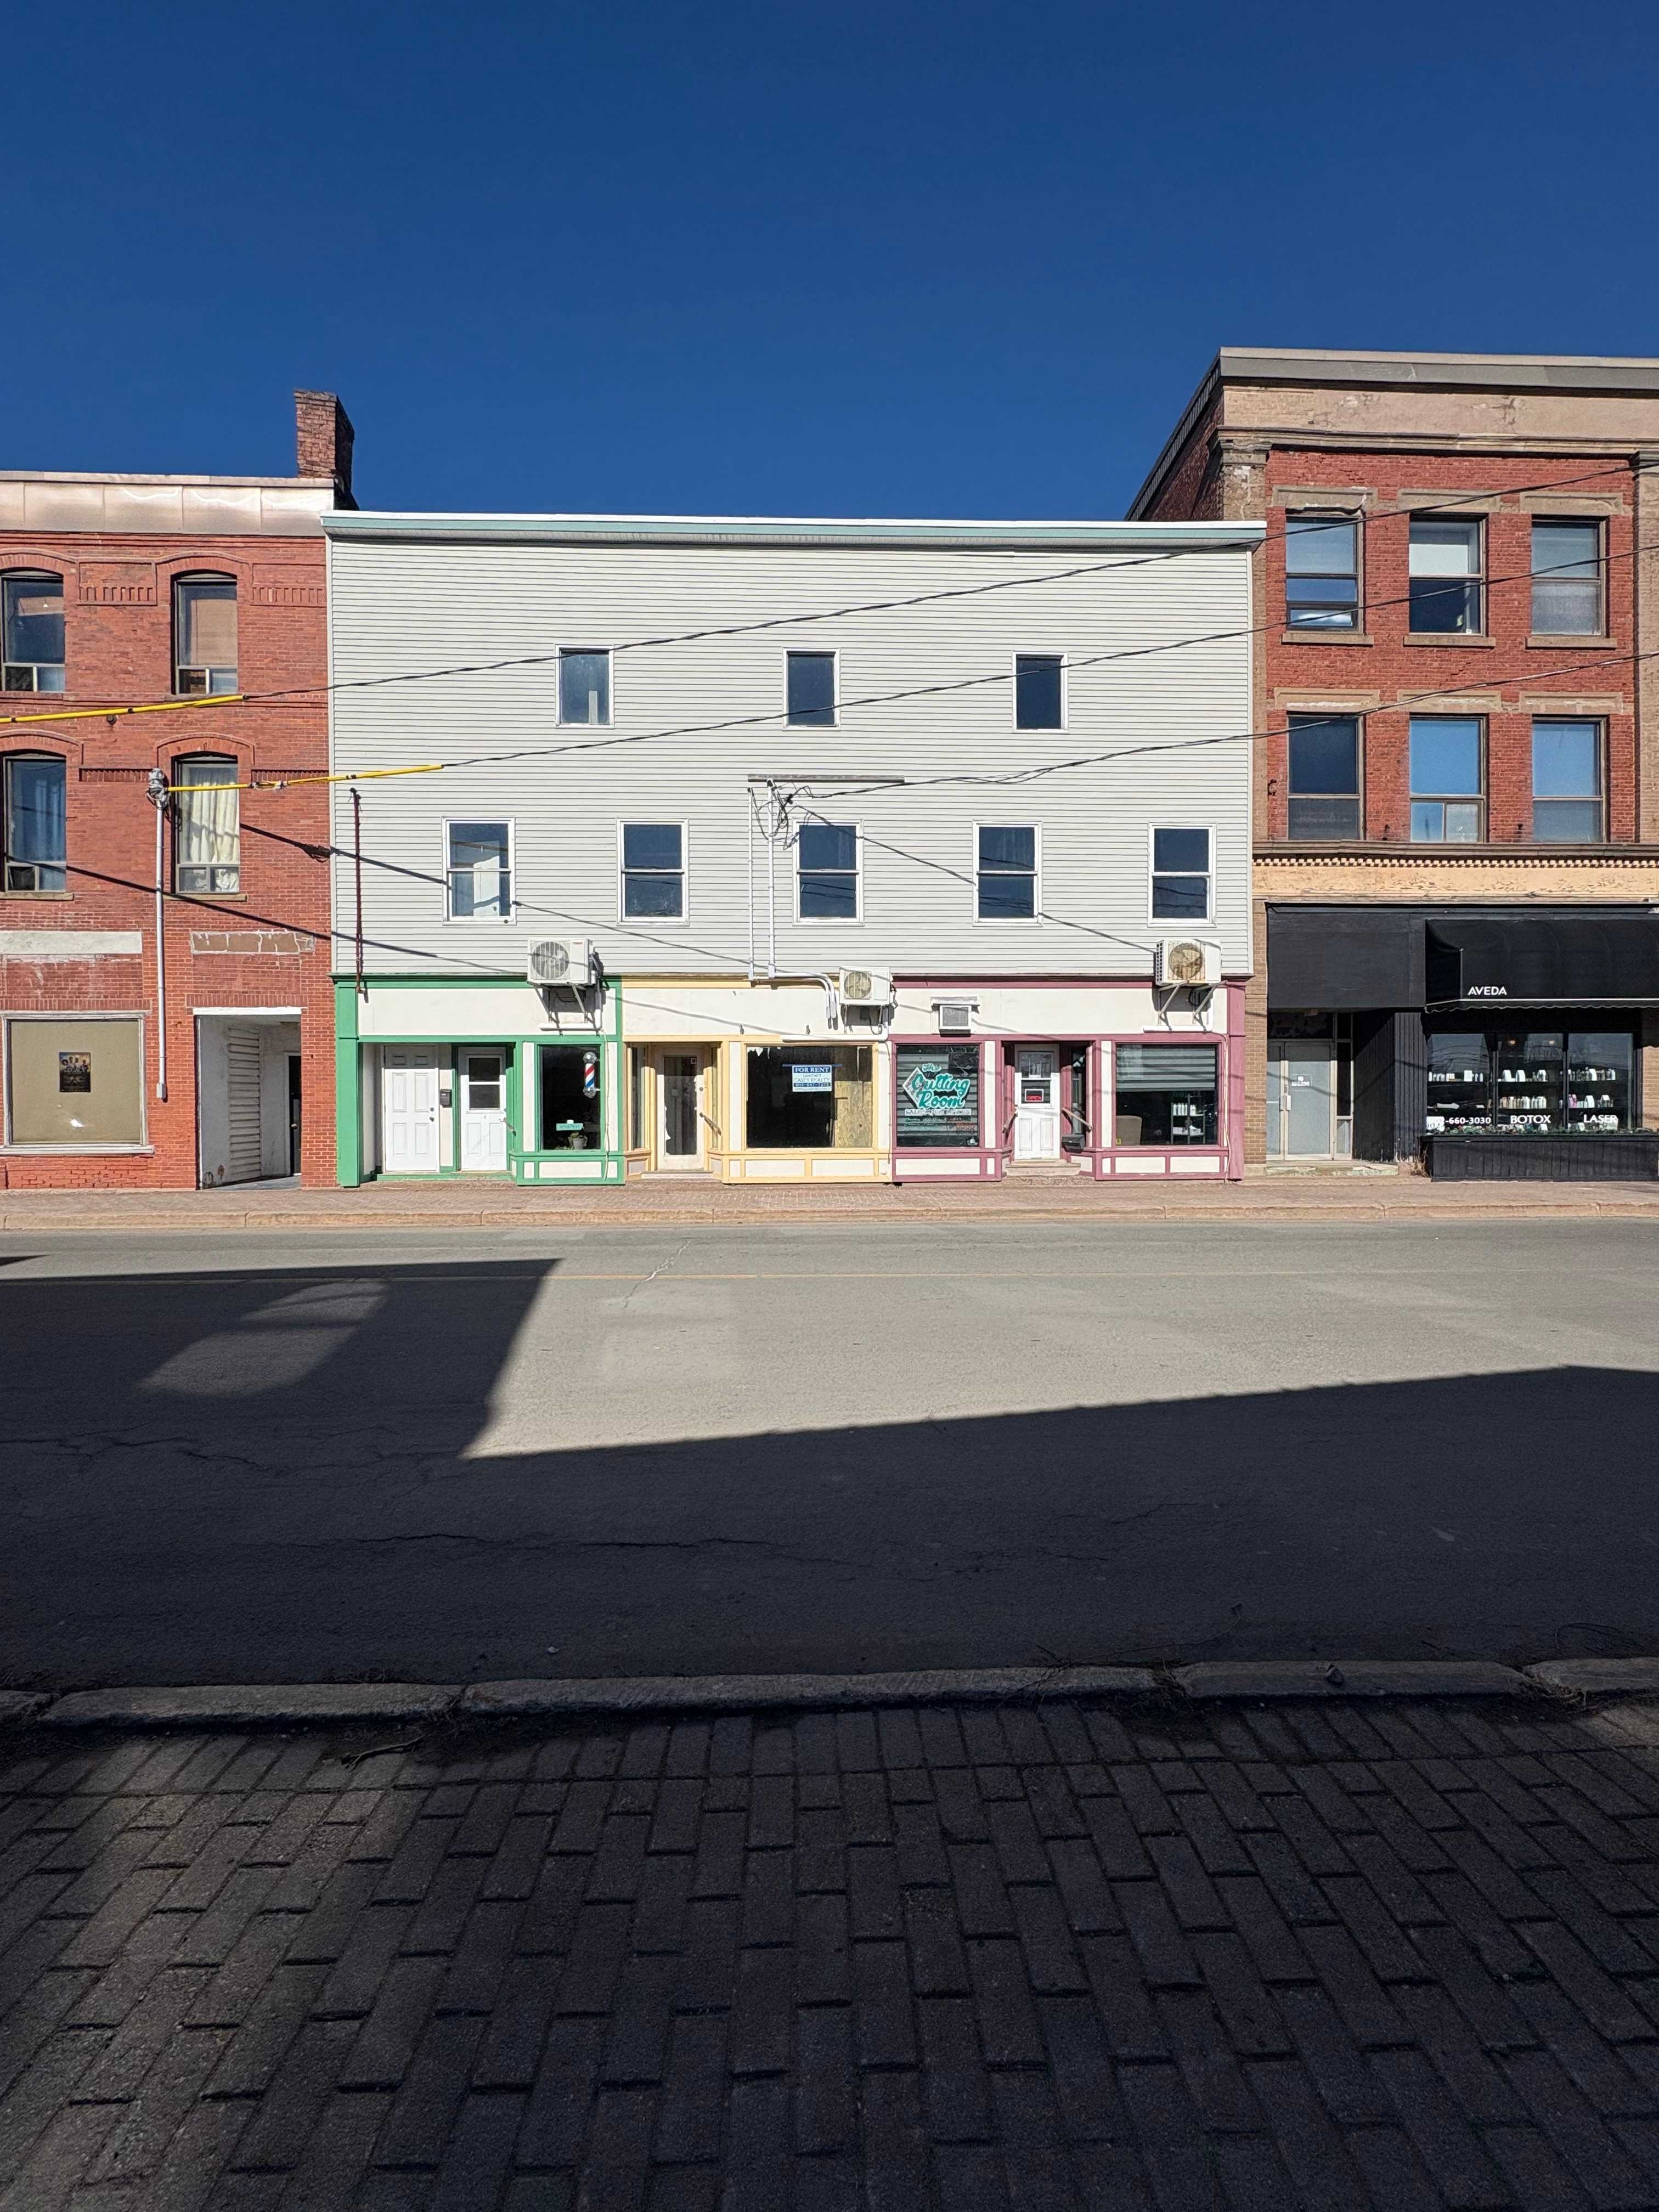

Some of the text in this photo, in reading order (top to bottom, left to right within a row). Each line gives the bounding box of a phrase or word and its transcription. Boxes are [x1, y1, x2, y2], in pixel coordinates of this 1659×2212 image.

[1467, 986, 1508, 996] AVEDA
[922, 1063, 941, 1072] The
[911, 1073, 970, 1097] Cutting
[916, 1090, 965, 1108] Room
[1510, 1114, 1551, 1124] BOTOX
[1583, 1114, 1617, 1123] LASER
